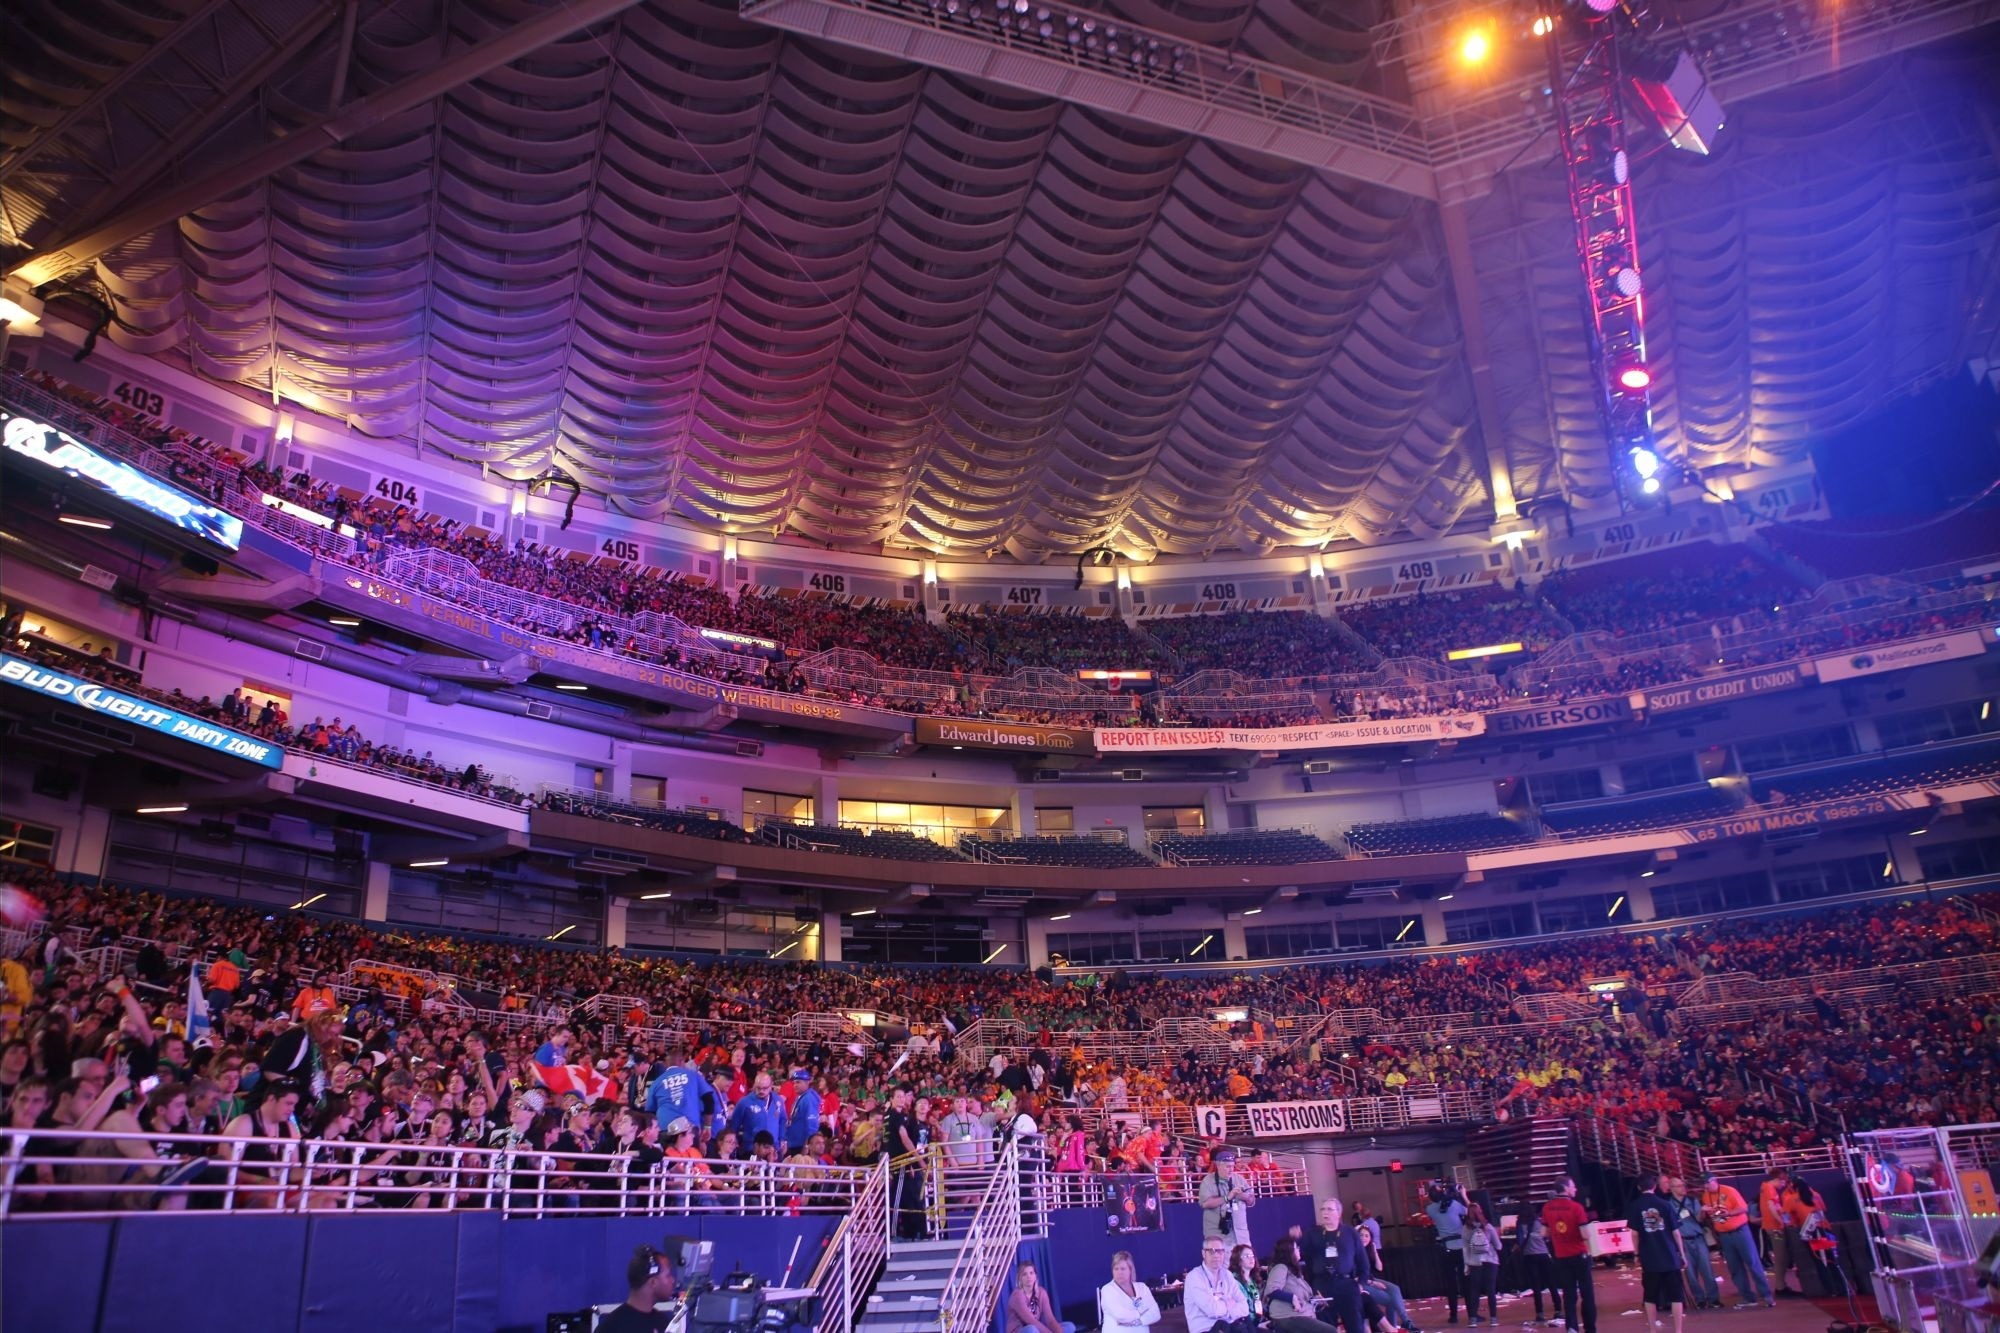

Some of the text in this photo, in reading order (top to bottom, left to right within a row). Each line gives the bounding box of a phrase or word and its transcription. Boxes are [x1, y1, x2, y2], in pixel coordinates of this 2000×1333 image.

[113, 381, 165, 417] 403
[375, 477, 418, 505] 404
[1759, 488, 1789, 508] 411
[1604, 524, 1635, 543] 410
[601, 538, 639, 561] 405
[809, 573, 845, 592] 406
[1398, 561, 1433, 580] 409
[1007, 587, 1041, 604] 407
[1202, 583, 1236, 600] 408
[421, 600, 493, 639] VERMEIL
[639, 668, 841, 720] 22 ROGER WEHRLI 1969-82
[1651, 670, 1796, 710] SCOTT CREDIT UNION
[0, 659, 269, 761] BUD LIGHT PARTY ZONE
[1498, 702, 1622, 732] EMERSON
[1101, 732, 1150, 746] REPORT
[1153, 732, 1178, 745] FAN
[1179, 730, 1225, 745] ISSUES!
[1229, 733, 1249, 743] TEXT
[1250, 734, 1277, 743] 69050
[1357, 726, 1380, 738] ISSUE
[1382, 727, 1390, 736] &
[1391, 723, 1432, 735] LOCATION
[1697, 801, 1885, 842] 65 TOM MACK 1966-78
[662, 1073, 689, 1090] 1325
[1205, 1110, 1221, 1137] C
[1251, 1104, 1342, 1132] RESTROOMS
